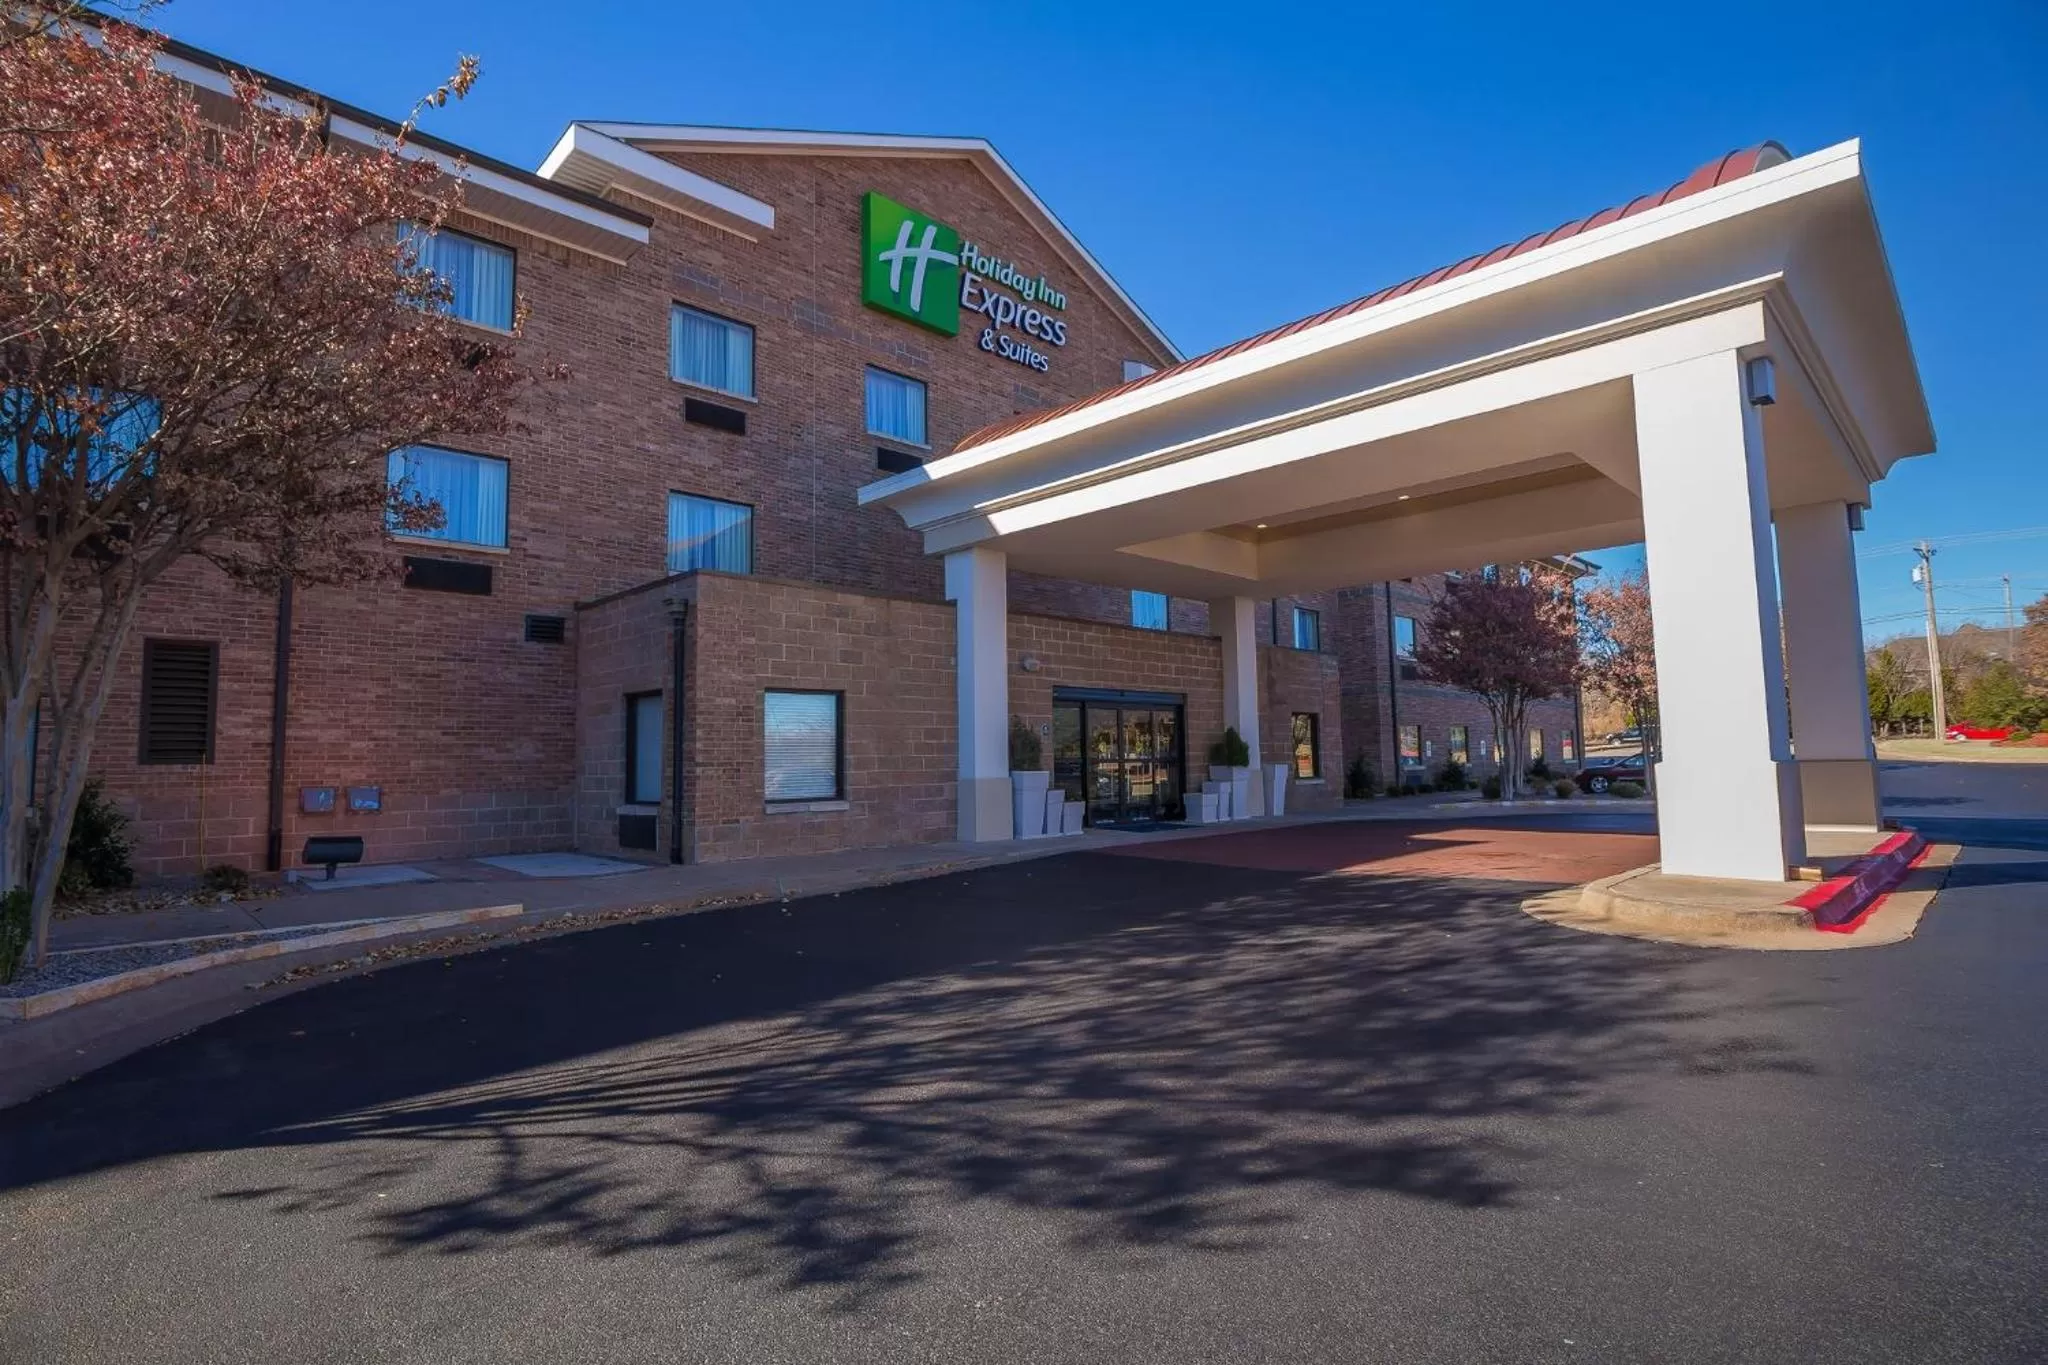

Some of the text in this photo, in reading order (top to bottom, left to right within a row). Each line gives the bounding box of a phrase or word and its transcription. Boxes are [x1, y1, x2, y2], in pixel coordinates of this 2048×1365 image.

[878, 219, 959, 313] H
[960, 241, 1067, 311] Holiday Inn
[961, 271, 1068, 346] Express
[981, 328, 1049, 372] & Suites
